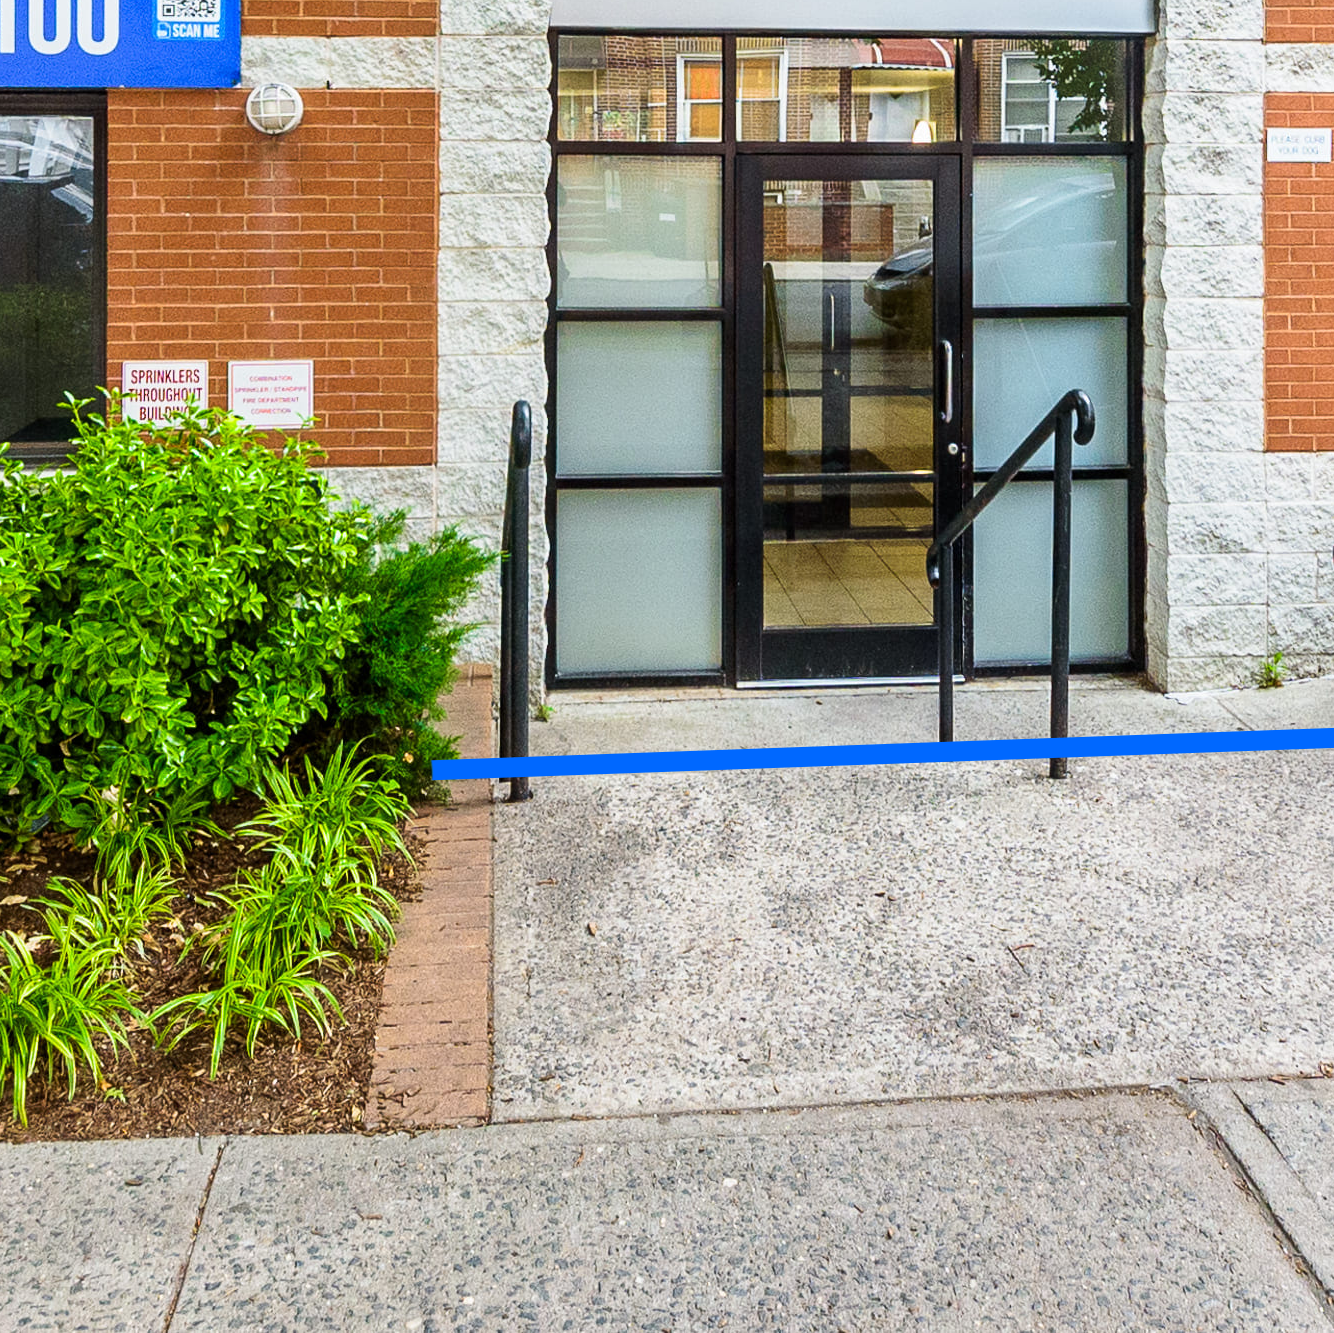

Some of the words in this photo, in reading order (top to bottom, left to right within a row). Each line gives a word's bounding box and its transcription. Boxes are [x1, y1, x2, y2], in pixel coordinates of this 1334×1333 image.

[172, 23, 202, 38] SCAN
[203, 24, 220, 38] ME
[130, 368, 200, 384] SPRINKLERS
[257, 396, 300, 404] DEPARTMENT
